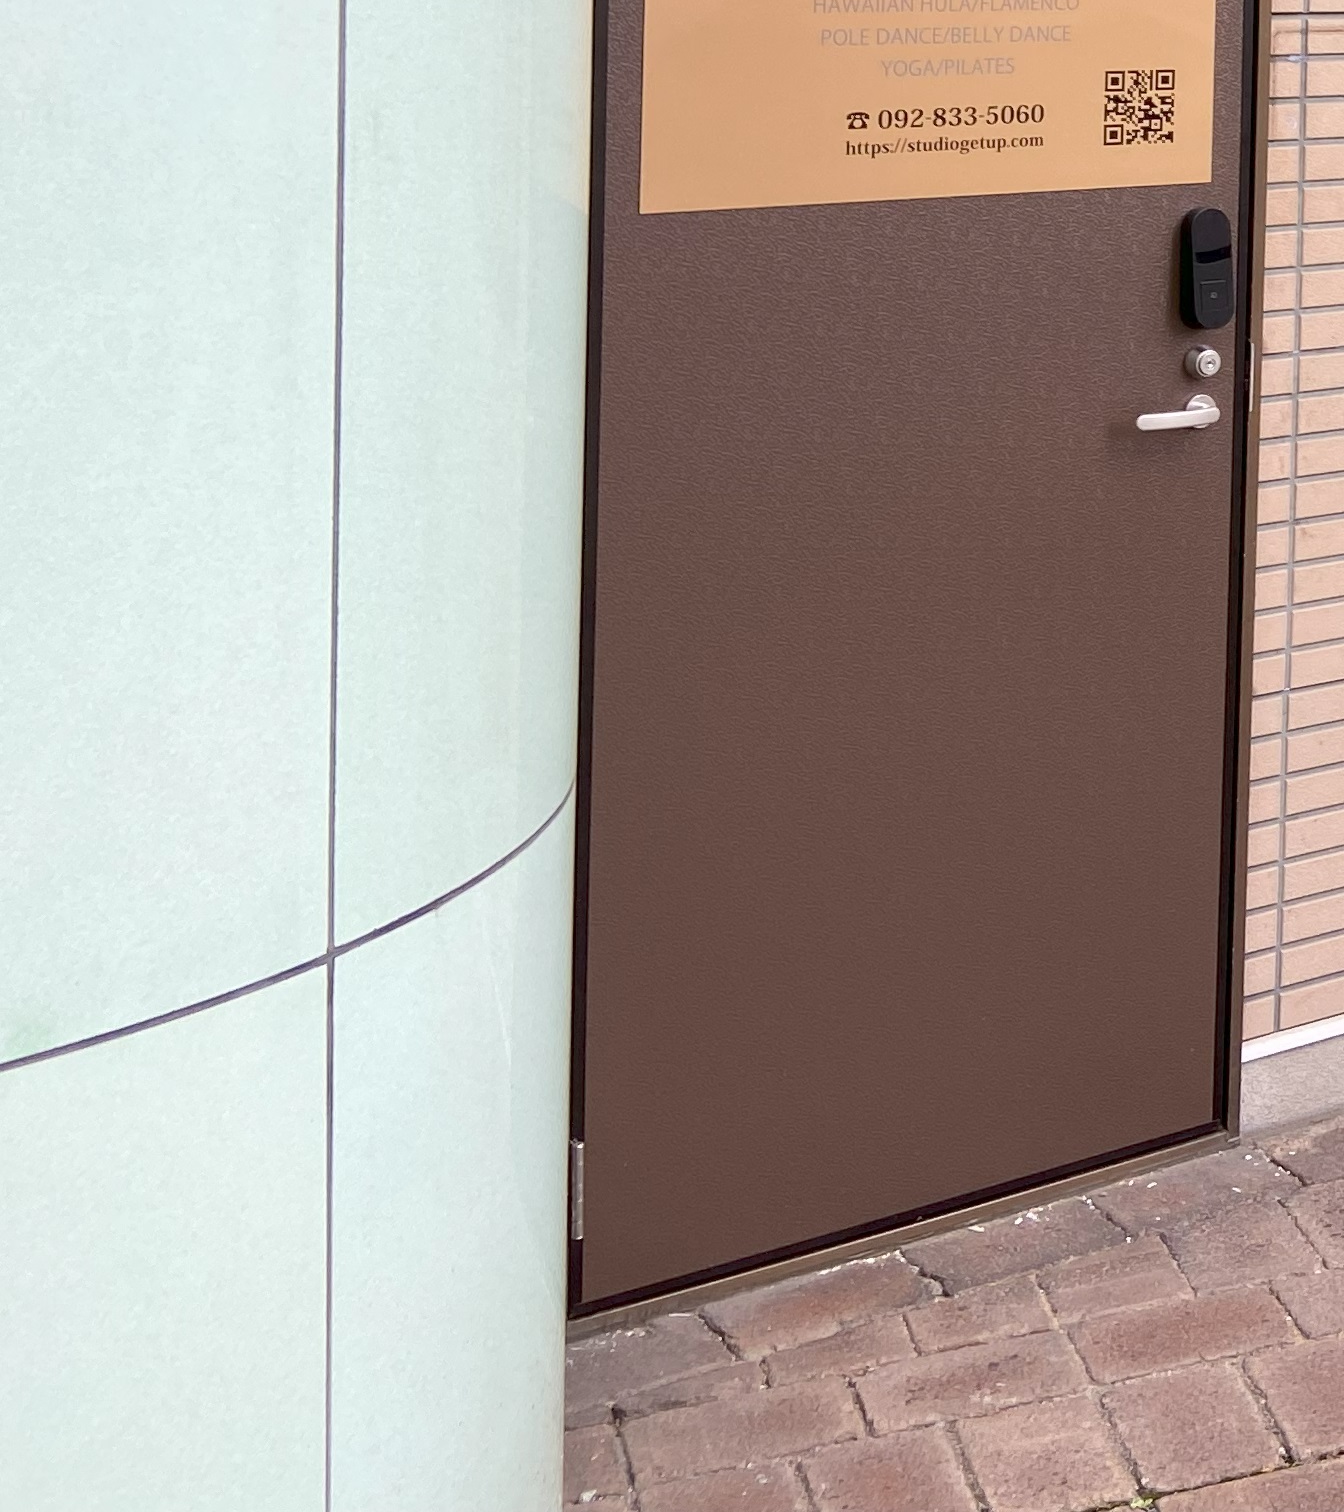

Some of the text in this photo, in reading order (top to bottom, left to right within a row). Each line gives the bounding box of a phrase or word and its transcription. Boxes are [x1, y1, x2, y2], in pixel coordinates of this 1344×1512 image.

[821, 24, 1072, 46] POLE DANCE/BELLY DANCE
[881, 56, 1016, 77] YOGA/PILATES
[878, 103, 1045, 130] 092-833-5060
[846, 136, 1044, 159] https://studiogetup.com
